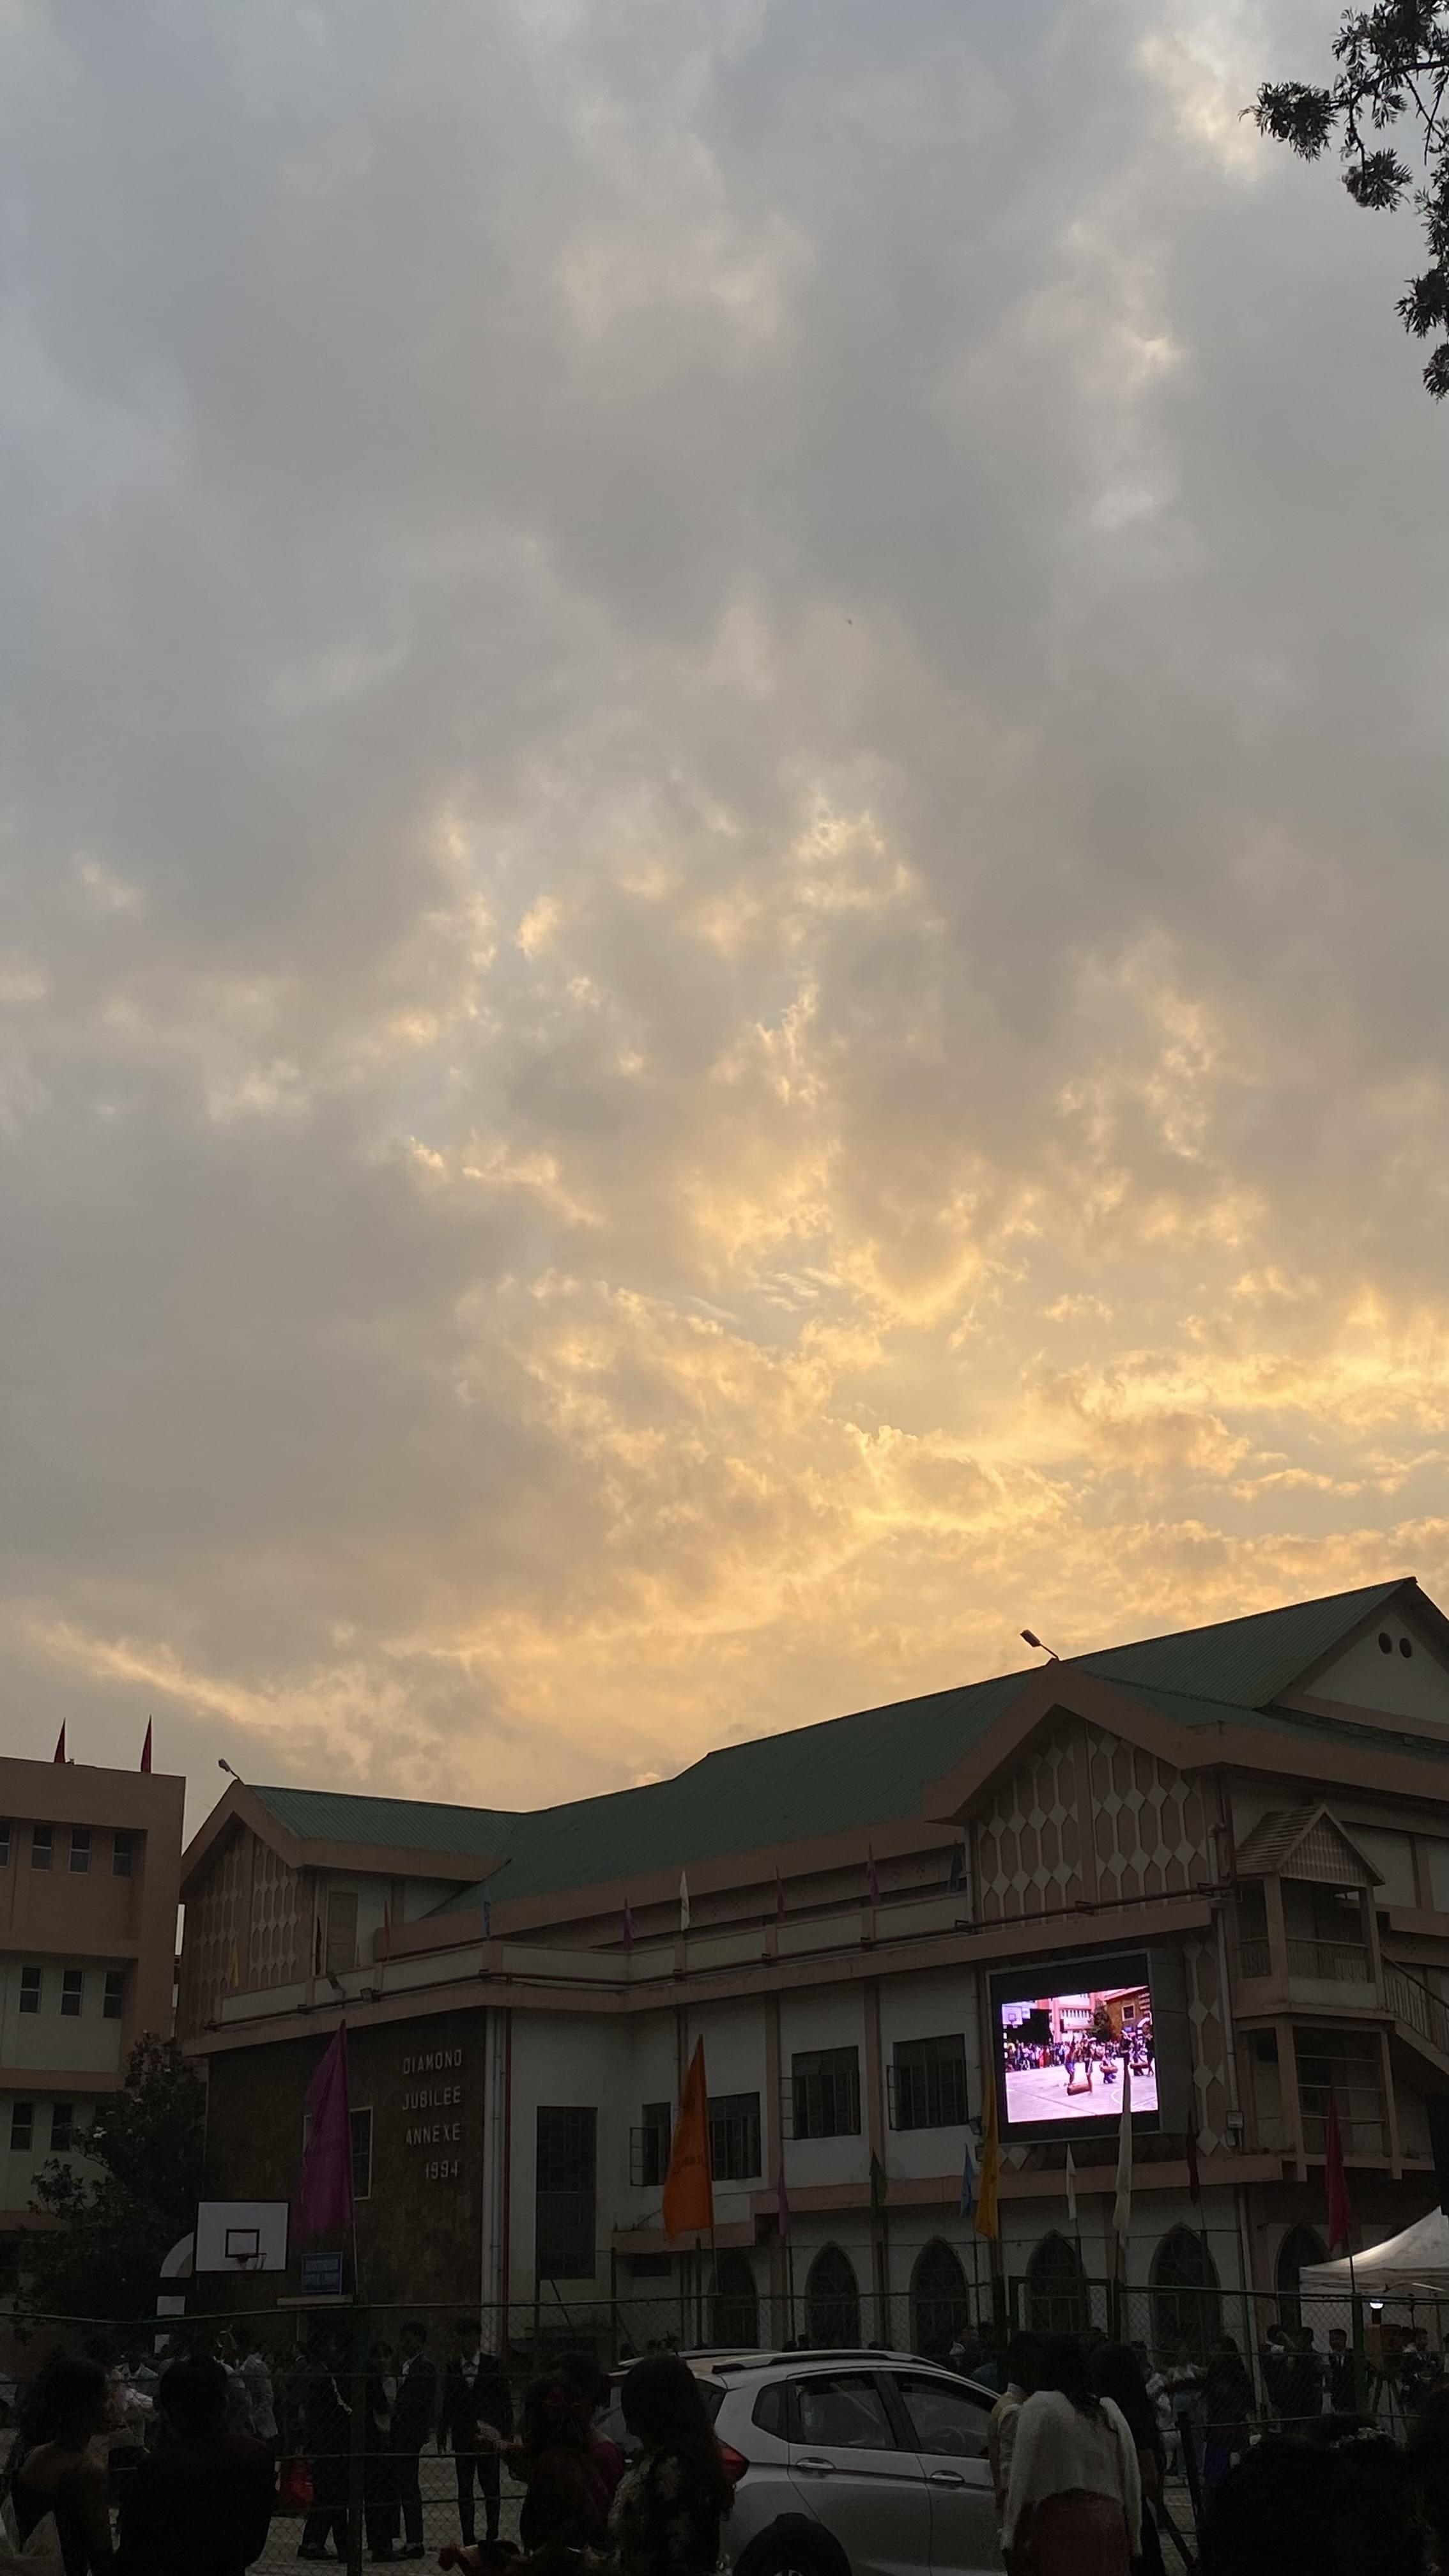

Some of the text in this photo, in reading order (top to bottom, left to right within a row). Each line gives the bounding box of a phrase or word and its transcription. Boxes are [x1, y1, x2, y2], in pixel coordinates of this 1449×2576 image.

[403, 2049, 462, 2075] DIAMOND
[402, 2085, 461, 2110] JUBILEE
[406, 2122, 460, 2145] ANNEXE
[425, 2159, 459, 2180] 1994
